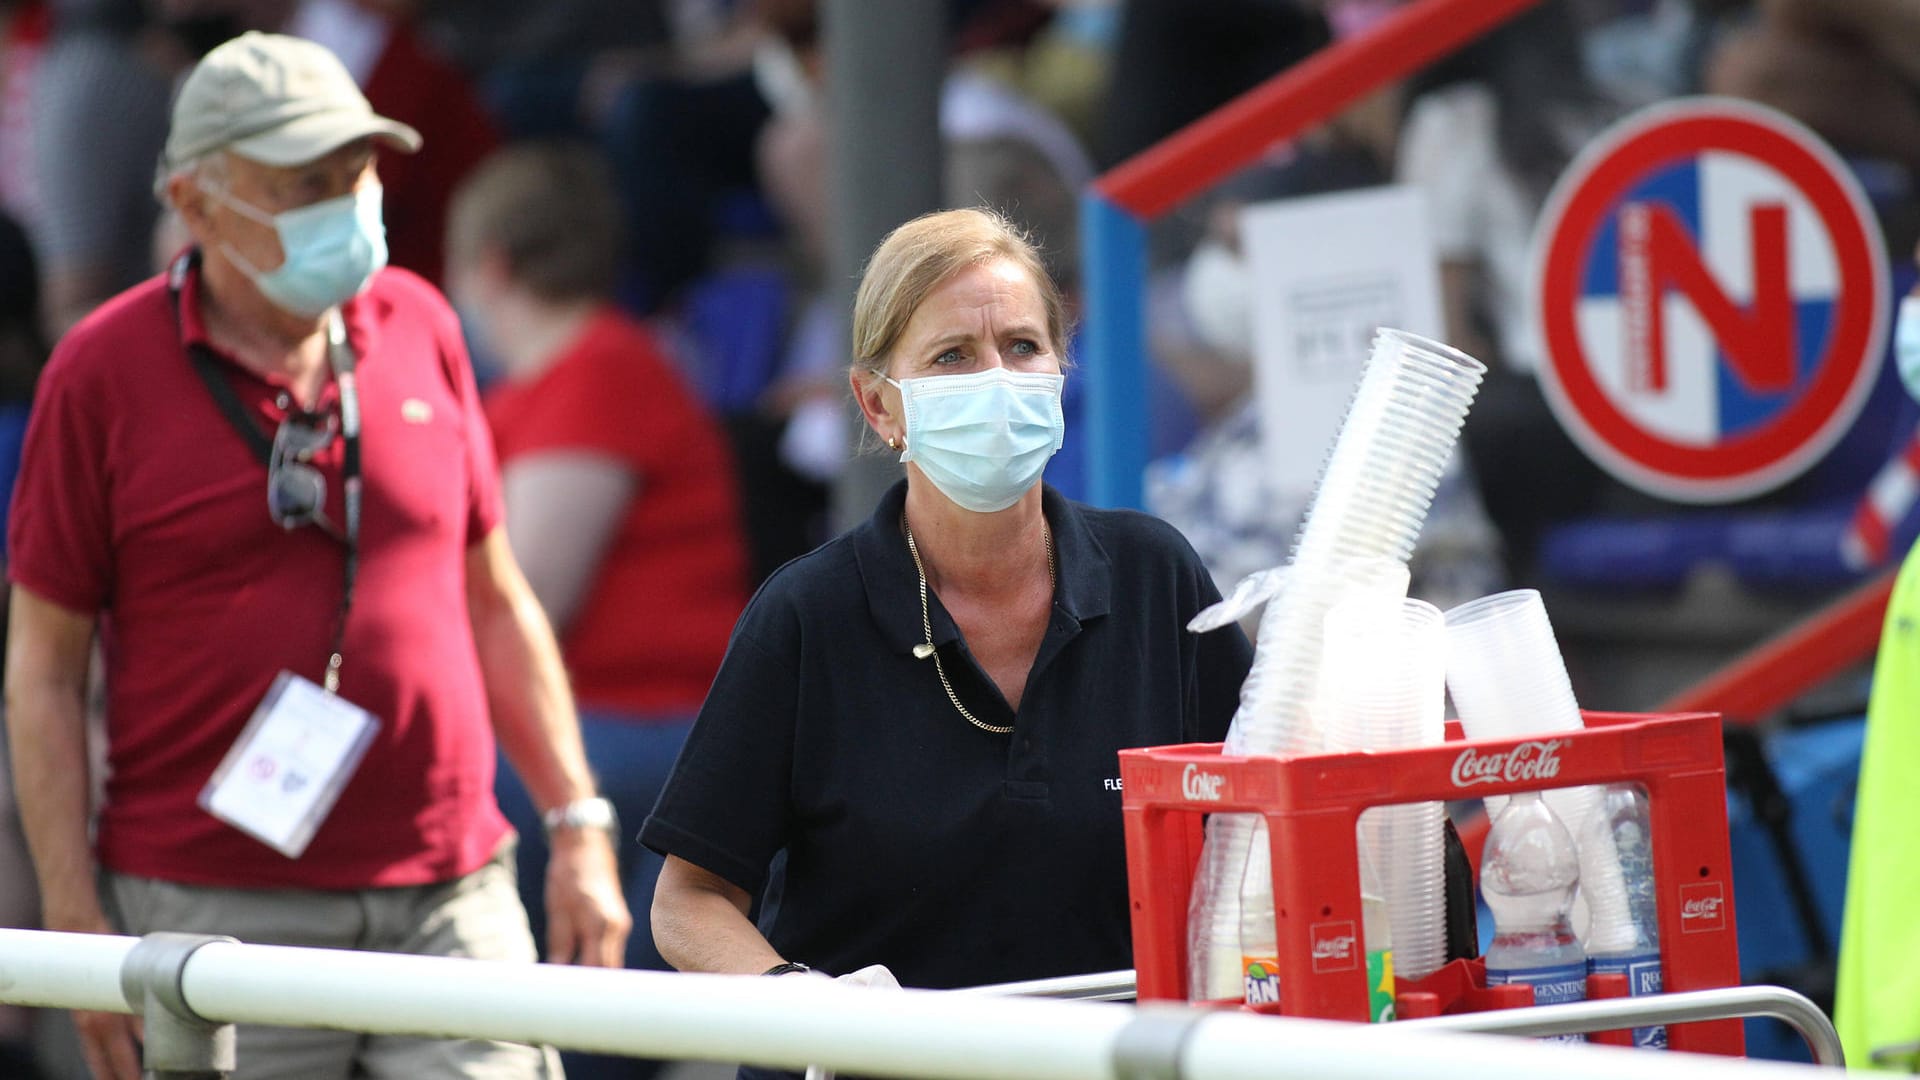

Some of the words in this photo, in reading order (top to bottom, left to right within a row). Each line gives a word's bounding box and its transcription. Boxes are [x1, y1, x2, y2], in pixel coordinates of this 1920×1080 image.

[1622, 203, 1798, 395] N
[1182, 763, 1222, 800] Coke
[1451, 739, 1561, 787] Coca-Cola
[1104, 778, 1123, 790] FLE
[1244, 974, 1280, 1004] FAN
